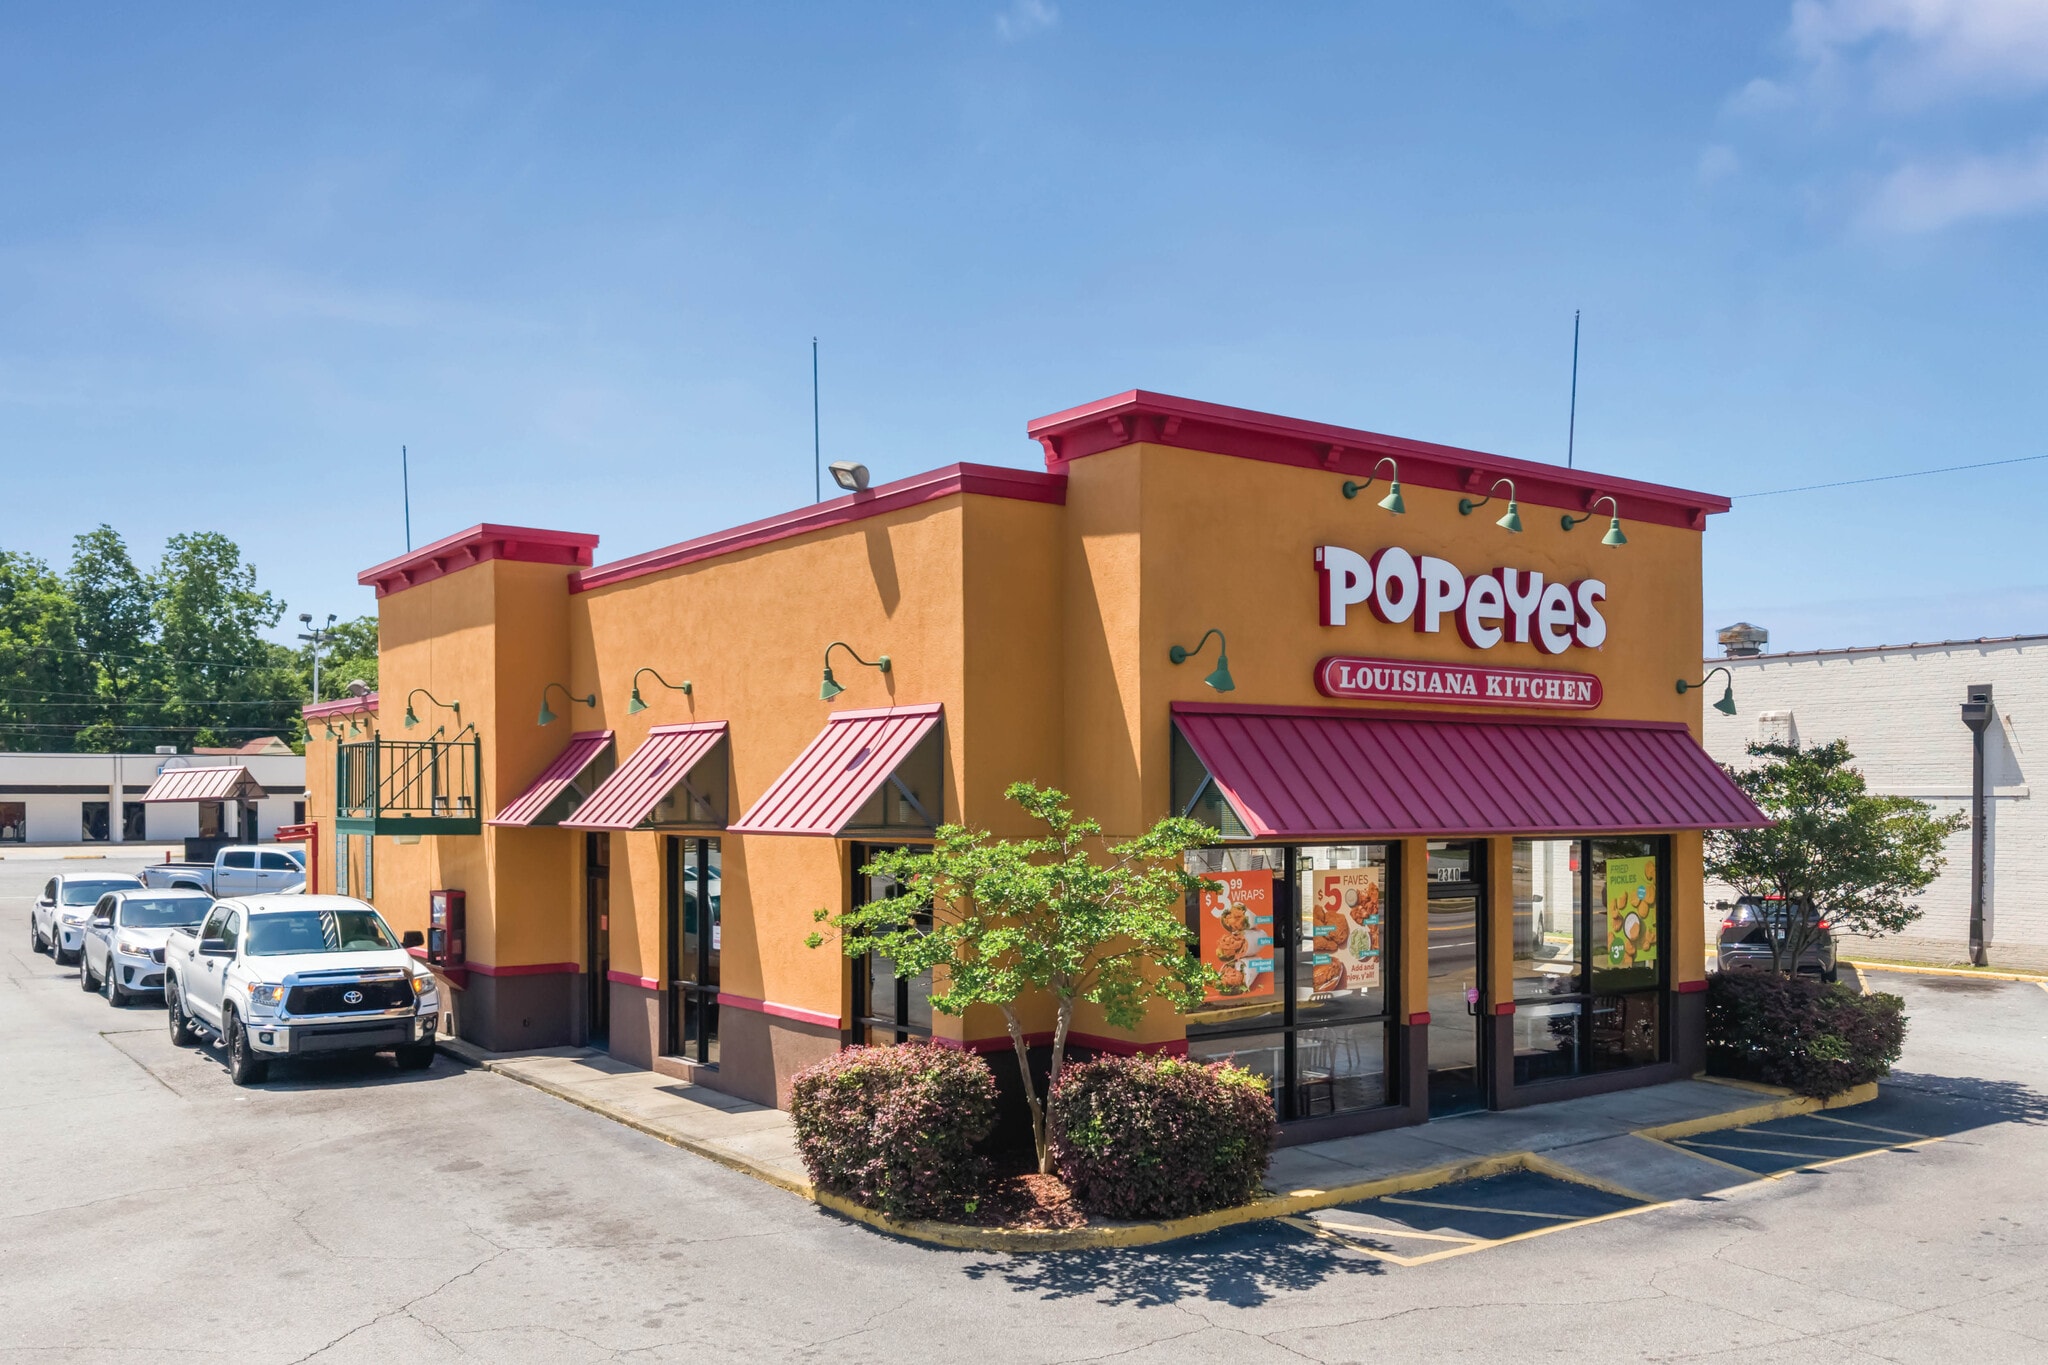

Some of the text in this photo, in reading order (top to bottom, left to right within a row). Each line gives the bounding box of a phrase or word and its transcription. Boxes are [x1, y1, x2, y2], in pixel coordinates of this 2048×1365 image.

[1339, 666, 1593, 702] LOUISIANA KITCHEN
[1438, 867, 1460, 882] 2340
[1610, 863, 1629, 874] FRIED
[1343, 874, 1369, 886] FAVES
[1610, 874, 1637, 886] PICKLES
[1231, 888, 1265, 901] WRAPS
